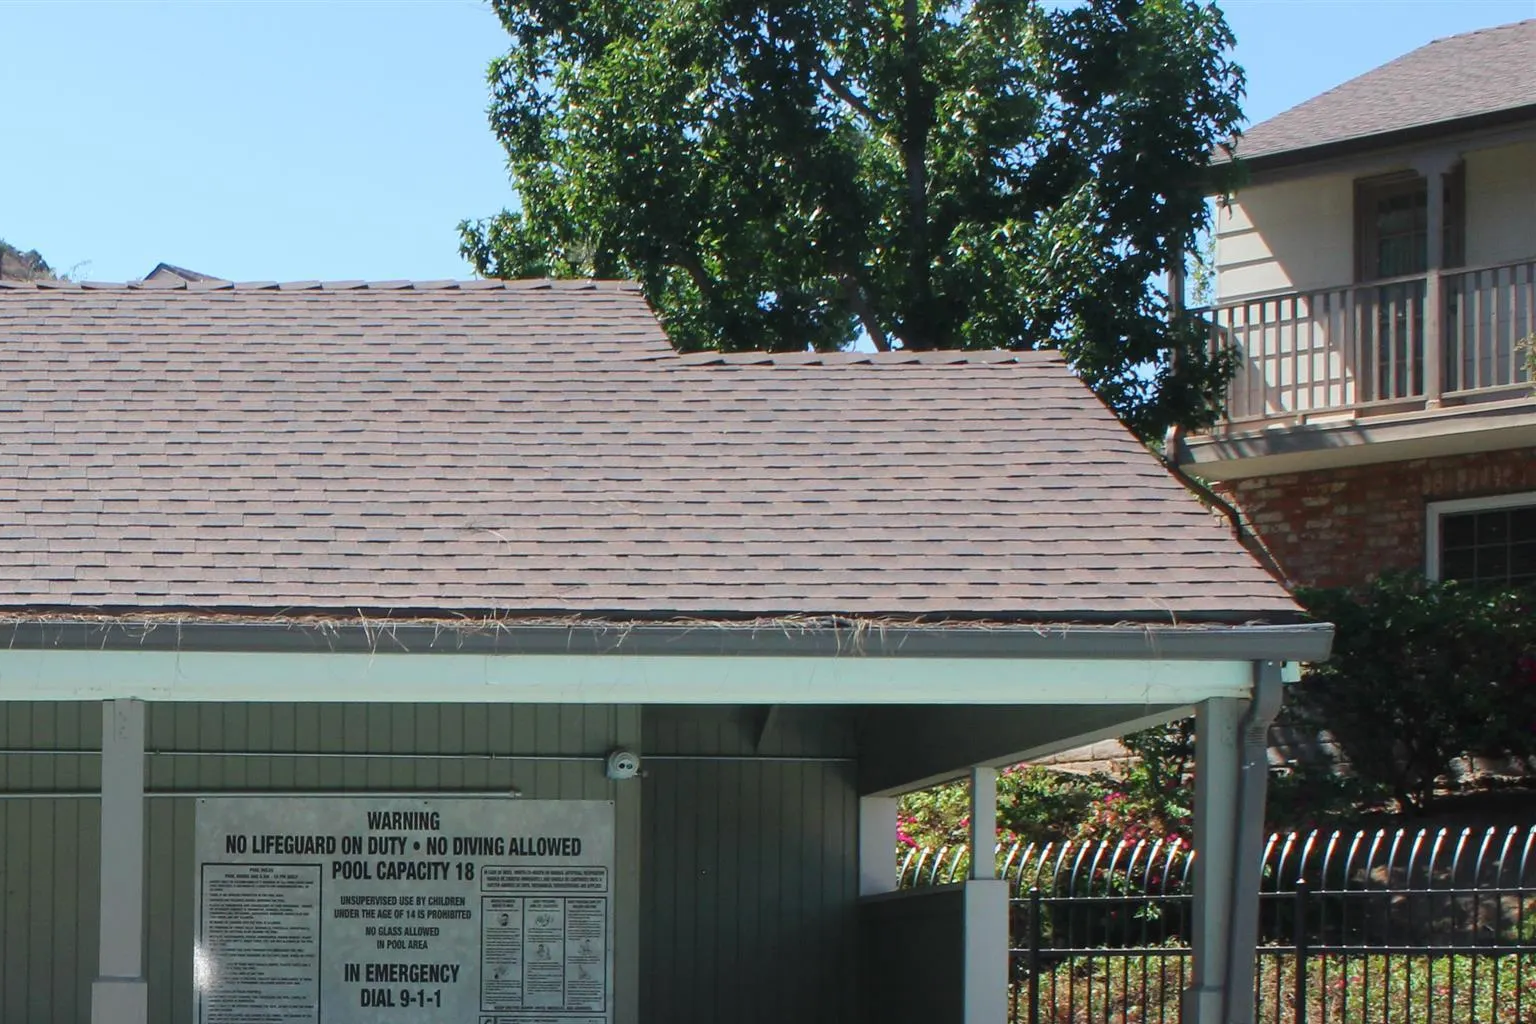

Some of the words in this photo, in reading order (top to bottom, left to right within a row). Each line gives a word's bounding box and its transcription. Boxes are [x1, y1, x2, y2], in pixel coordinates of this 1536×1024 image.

[367, 812, 440, 831] WARNING
[225, 835, 248, 854] NO
[252, 835, 337, 855] LIFEGUARD
[341, 836, 363, 855] ON
[368, 836, 407, 856] DUTY
[427, 837, 448, 856] NO
[452, 837, 505, 857] DIVING
[508, 838, 582, 857] ALLOWED
[332, 861, 371, 880] POOL
[376, 862, 451, 881] CAPACITY
[455, 863, 475, 882] 18
[340, 896, 397, 906] UNSUPERVISED
[399, 896, 414, 906] USE
[416, 896, 426, 906] BY
[427, 897, 466, 907] CHILDREN
[334, 909, 360, 919] UNDER
[362, 909, 375, 919] THE
[377, 909, 392, 919] AGE
[394, 909, 404, 919] OF
[406, 910, 416, 919] 14
[417, 910, 425, 920] IS
[427, 910, 471, 920] PROHIBITED
[365, 926, 376, 936] NO
[378, 926, 402, 937] GLASS
[404, 927, 440, 937] ALLOWED
[376, 940, 385, 950] IN
[387, 940, 406, 950] POOL
[408, 940, 428, 950] AREA
[344, 963, 360, 982] IN
[365, 963, 460, 983] EMERGENCY
[360, 989, 395, 1008] DIAL
[400, 989, 441, 1008] 9-1-1
